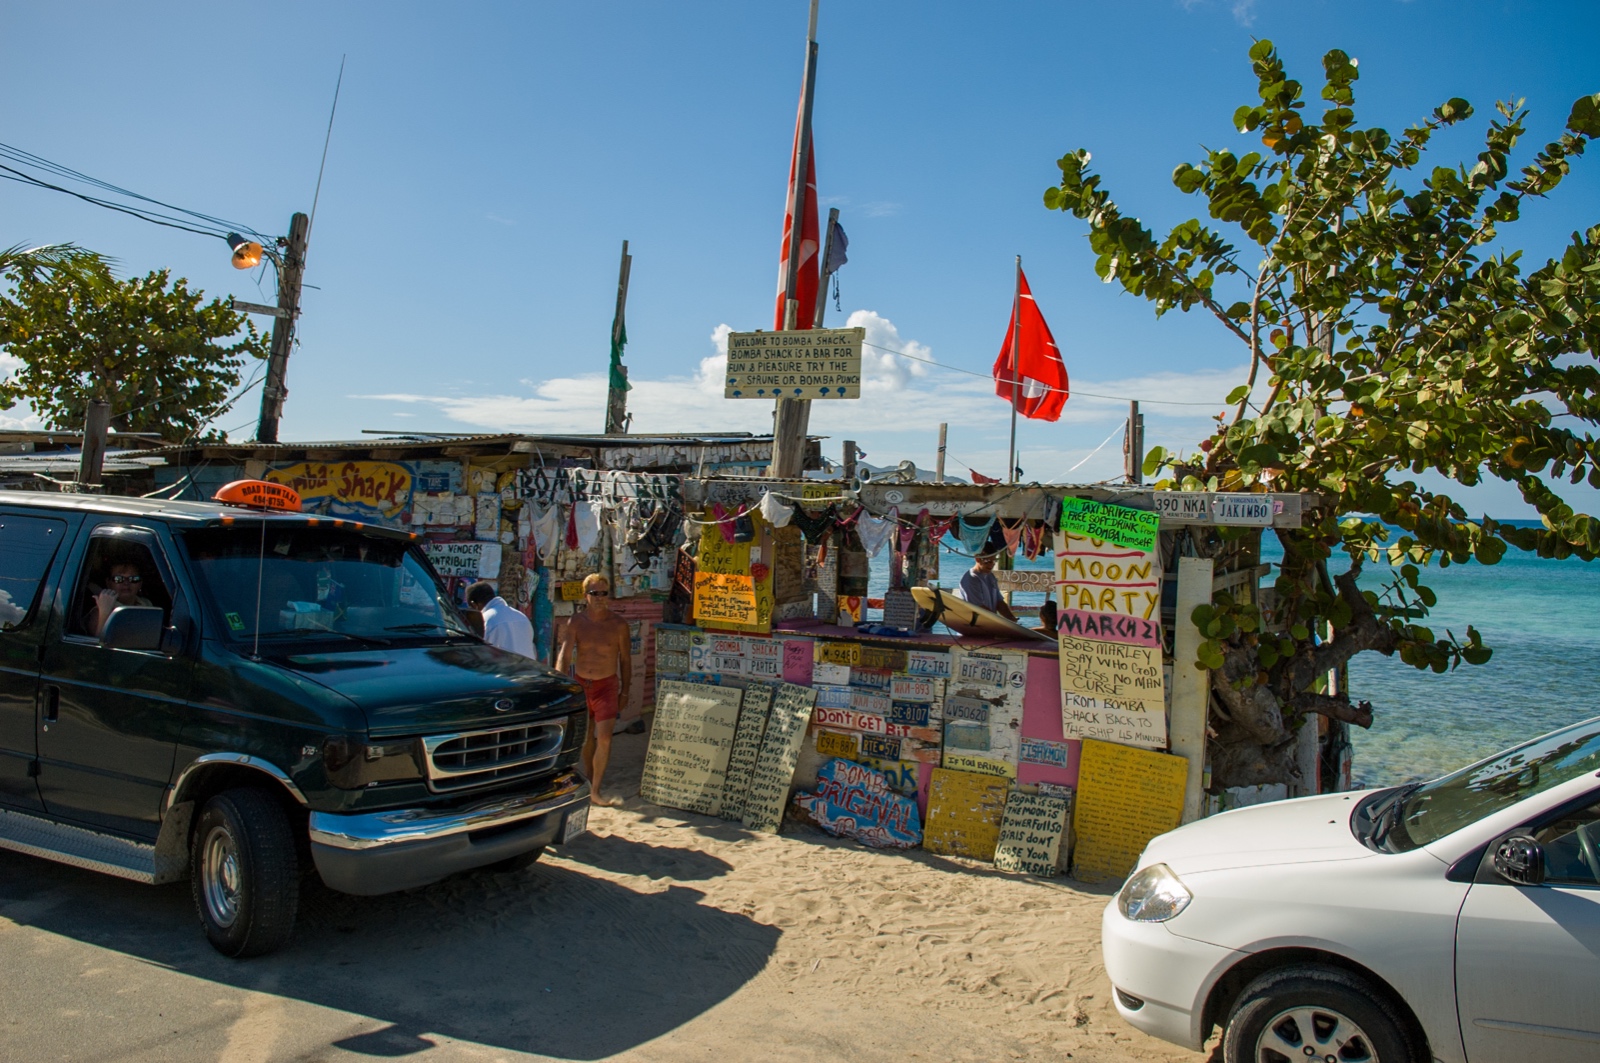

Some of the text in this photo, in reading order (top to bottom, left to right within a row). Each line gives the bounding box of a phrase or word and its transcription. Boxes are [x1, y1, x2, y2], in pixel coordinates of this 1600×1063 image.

[771, 337, 780, 346] TO
[783, 336, 812, 346] BOMBA
[731, 348, 853, 359] BOMBA SHACK iS A BAR FOR
[728, 362, 745, 372] FUN
[806, 362, 825, 372] TRY
[829, 362, 847, 371] THE
[783, 376, 796, 385] OR
[800, 375, 834, 385] BOMBA
[836, 375, 860, 384] PUNCH
[337, 462, 406, 506] Shack
[520, 467, 604, 504] BOMBA
[242, 485, 297, 504] ROAD TOWN TAXI
[1065, 500, 1159, 525] ALL TAXI DRIVER GET
[1156, 499, 1206, 512] 390 NKA
[1220, 504, 1268, 518] JAKIMBO
[1068, 511, 1156, 537] FREE SOFT DRiNK from
[1070, 522, 1085, 531] man
[1087, 524, 1120, 542] BOMBA
[1122, 533, 1152, 547] himself
[1060, 557, 1152, 581] MOON
[1062, 584, 1159, 620] PARTY
[228, 615, 240, 624] 10
[1058, 613, 1136, 639] MARCH
[668, 634, 678, 646] 20
[1062, 638, 1151, 665] BOB MARLEY
[668, 655, 677, 667] 20
[1066, 651, 1157, 677] SAY WHO GOD
[961, 664, 979, 678] BIF
[1066, 663, 1161, 689] BLESS NO MAN
[1072, 677, 1123, 695] CURSE
[1065, 692, 1146, 712] FROM BOMBA
[817, 708, 852, 724] Don't
[858, 715, 882, 731] GET
[886, 723, 911, 736] BiT
[1063, 709, 1152, 728] SHACK BACK TO
[1064, 722, 1166, 744] THE SHIP 45 MINUTES
[948, 757, 959, 765] IF
[960, 758, 975, 766] YOU
[977, 762, 1007, 775] BRING
[815, 776, 920, 838] ORIGINAL
[1007, 794, 1036, 806] SugAR
[1038, 798, 1046, 806] iS
[1006, 806, 1059, 819] THE MOON iS
[1000, 830, 1054, 848] giRlS doNT
[1027, 847, 1049, 861] YOUR
[1032, 863, 1056, 877] SAFE
